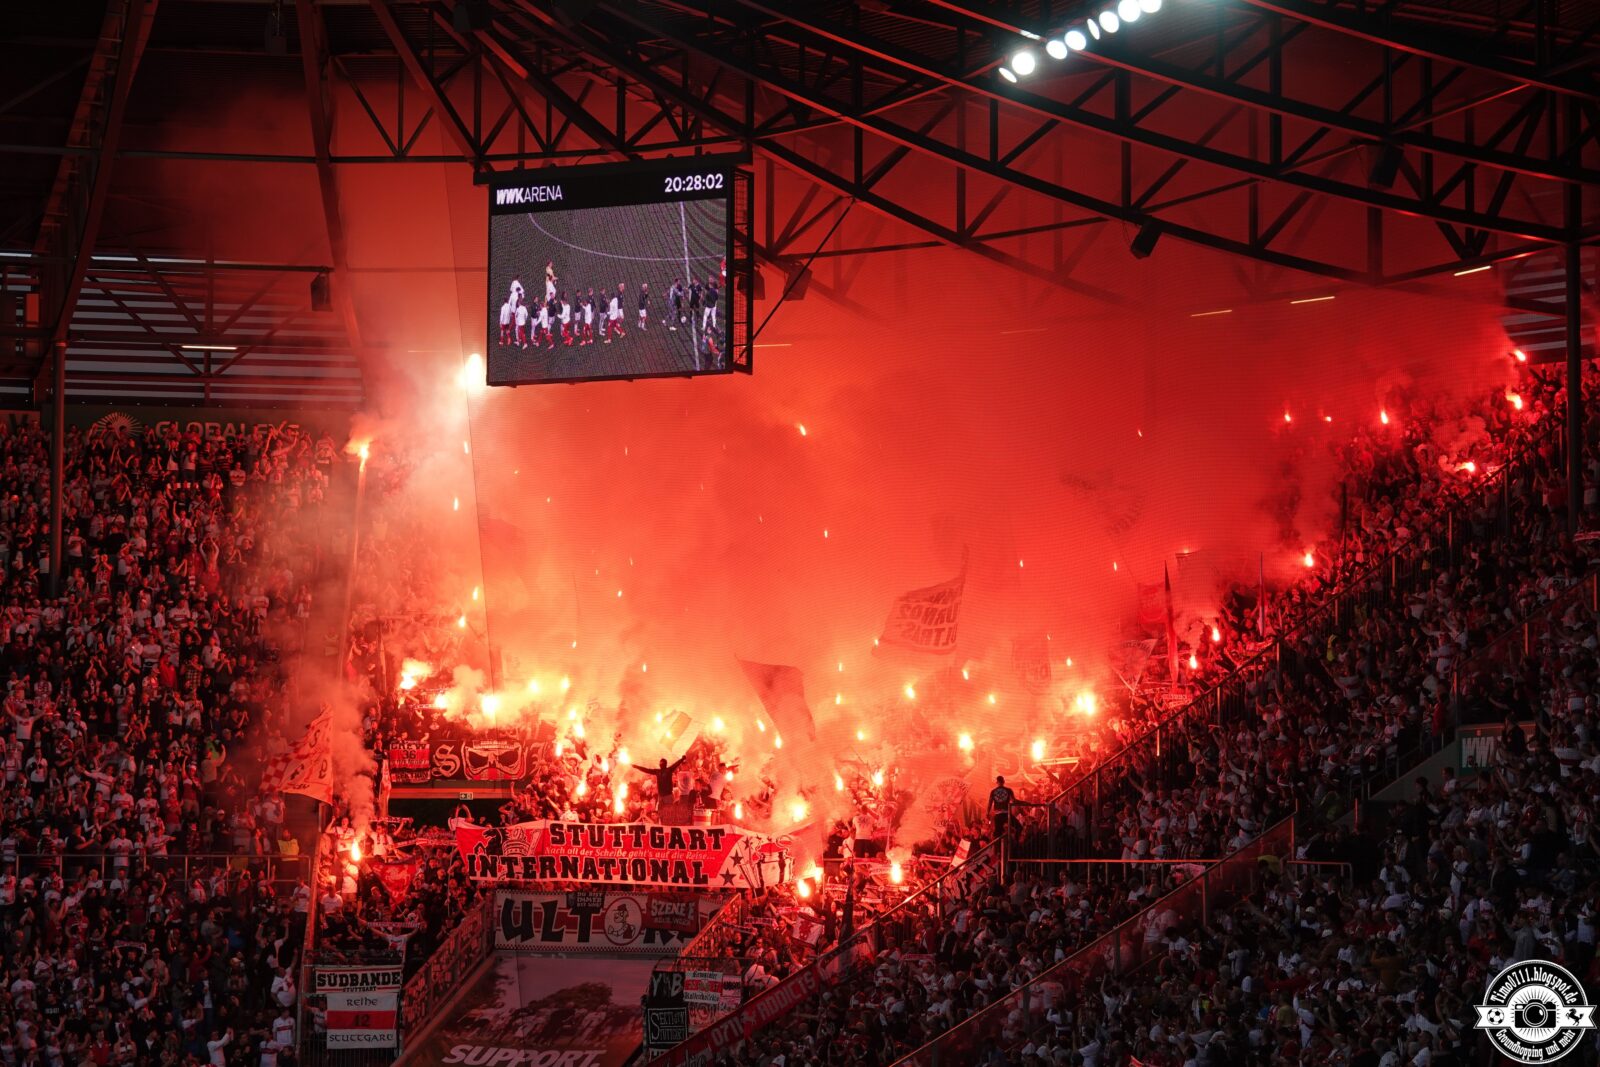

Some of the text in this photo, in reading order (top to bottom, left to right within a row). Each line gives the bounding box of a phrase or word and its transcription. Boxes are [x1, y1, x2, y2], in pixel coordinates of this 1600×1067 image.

[664, 173, 724, 193] 20:28:02
[400, 749, 417, 760] 36
[549, 822, 726, 851] STUTTGART
[580, 848, 593, 856] der
[466, 853, 710, 885] INTERNATIONAL
[651, 898, 686, 917] SZENE
[317, 972, 401, 987] SÜDBANDE
[711, 1018, 744, 1047] 0711
[757, 970, 818, 1021] ADDICTS
[353, 1014, 371, 1027] 12
